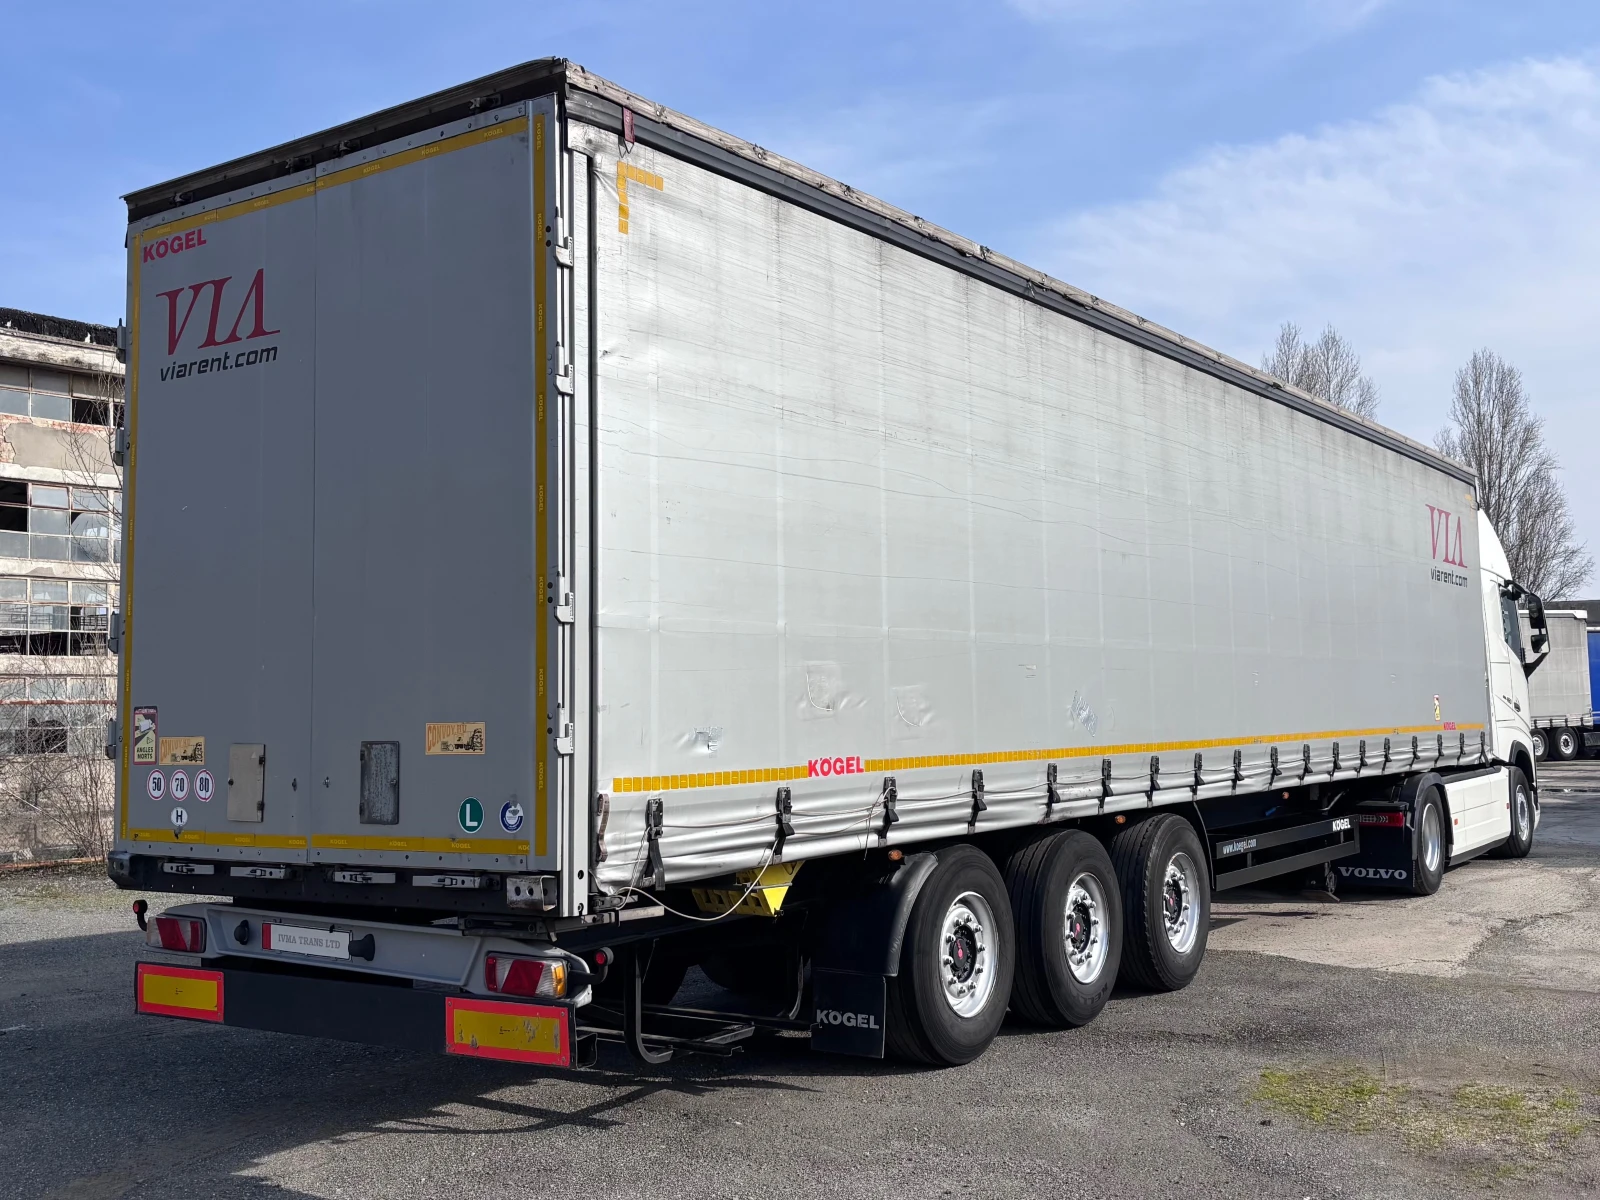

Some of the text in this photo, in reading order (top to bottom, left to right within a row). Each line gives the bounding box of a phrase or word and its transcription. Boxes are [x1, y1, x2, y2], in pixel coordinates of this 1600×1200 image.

[143, 228, 207, 263] KÖGEL
[156, 268, 280, 355] VIA
[160, 346, 278, 381] viarent.com
[1425, 503, 1468, 568] VIA
[1430, 566, 1468, 588] viarent.com
[808, 756, 864, 777] KÖGEL
[152, 777, 162, 791] 50
[175, 778, 185, 792] 70
[199, 777, 210, 792] 80
[175, 809, 183, 823] H
[465, 803, 478, 826] L
[1332, 818, 1351, 832] KÖGEL
[1338, 866, 1407, 880] VOLVO
[278, 933, 341, 949] IVMA TRANS LTD
[816, 1009, 880, 1029] KÖGEL
